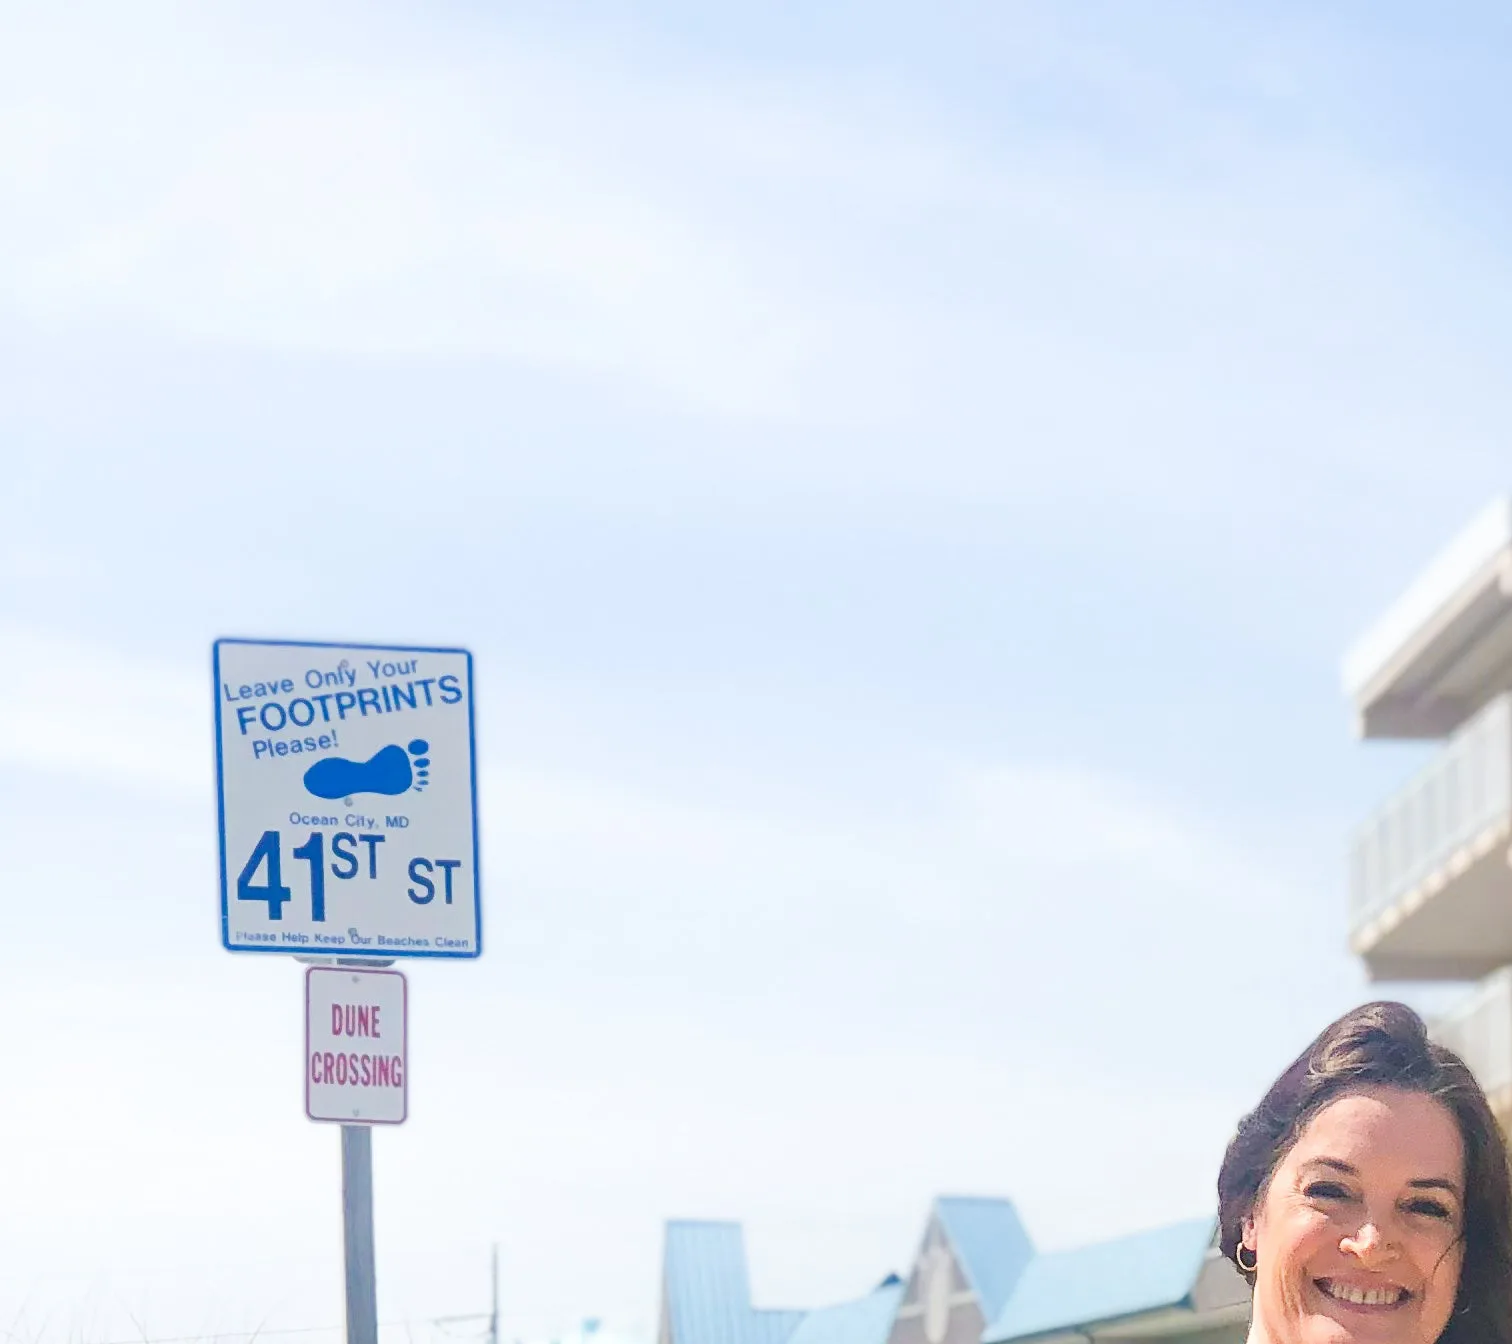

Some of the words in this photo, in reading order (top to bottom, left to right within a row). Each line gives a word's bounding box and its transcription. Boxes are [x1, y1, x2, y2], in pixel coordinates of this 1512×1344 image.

[223, 678, 294, 702] Leave
[304, 664, 356, 689] Only
[366, 659, 418, 680] Your
[236, 674, 463, 736] FOOTPRINTS
[252, 729, 339, 760] Please!
[289, 811, 339, 826] Ocean
[385, 815, 409, 828] MD
[237, 830, 385, 922] 41ST
[407, 857, 462, 905] ST
[236, 931, 276, 942] Please
[282, 932, 309, 945] Help
[314, 933, 345, 945] Keep
[350, 933, 371, 945] Our
[377, 934, 430, 946] Beaches
[434, 937, 469, 948] Clean
[331, 1003, 380, 1038] DUNE
[311, 1051, 402, 1088] CROSSING
